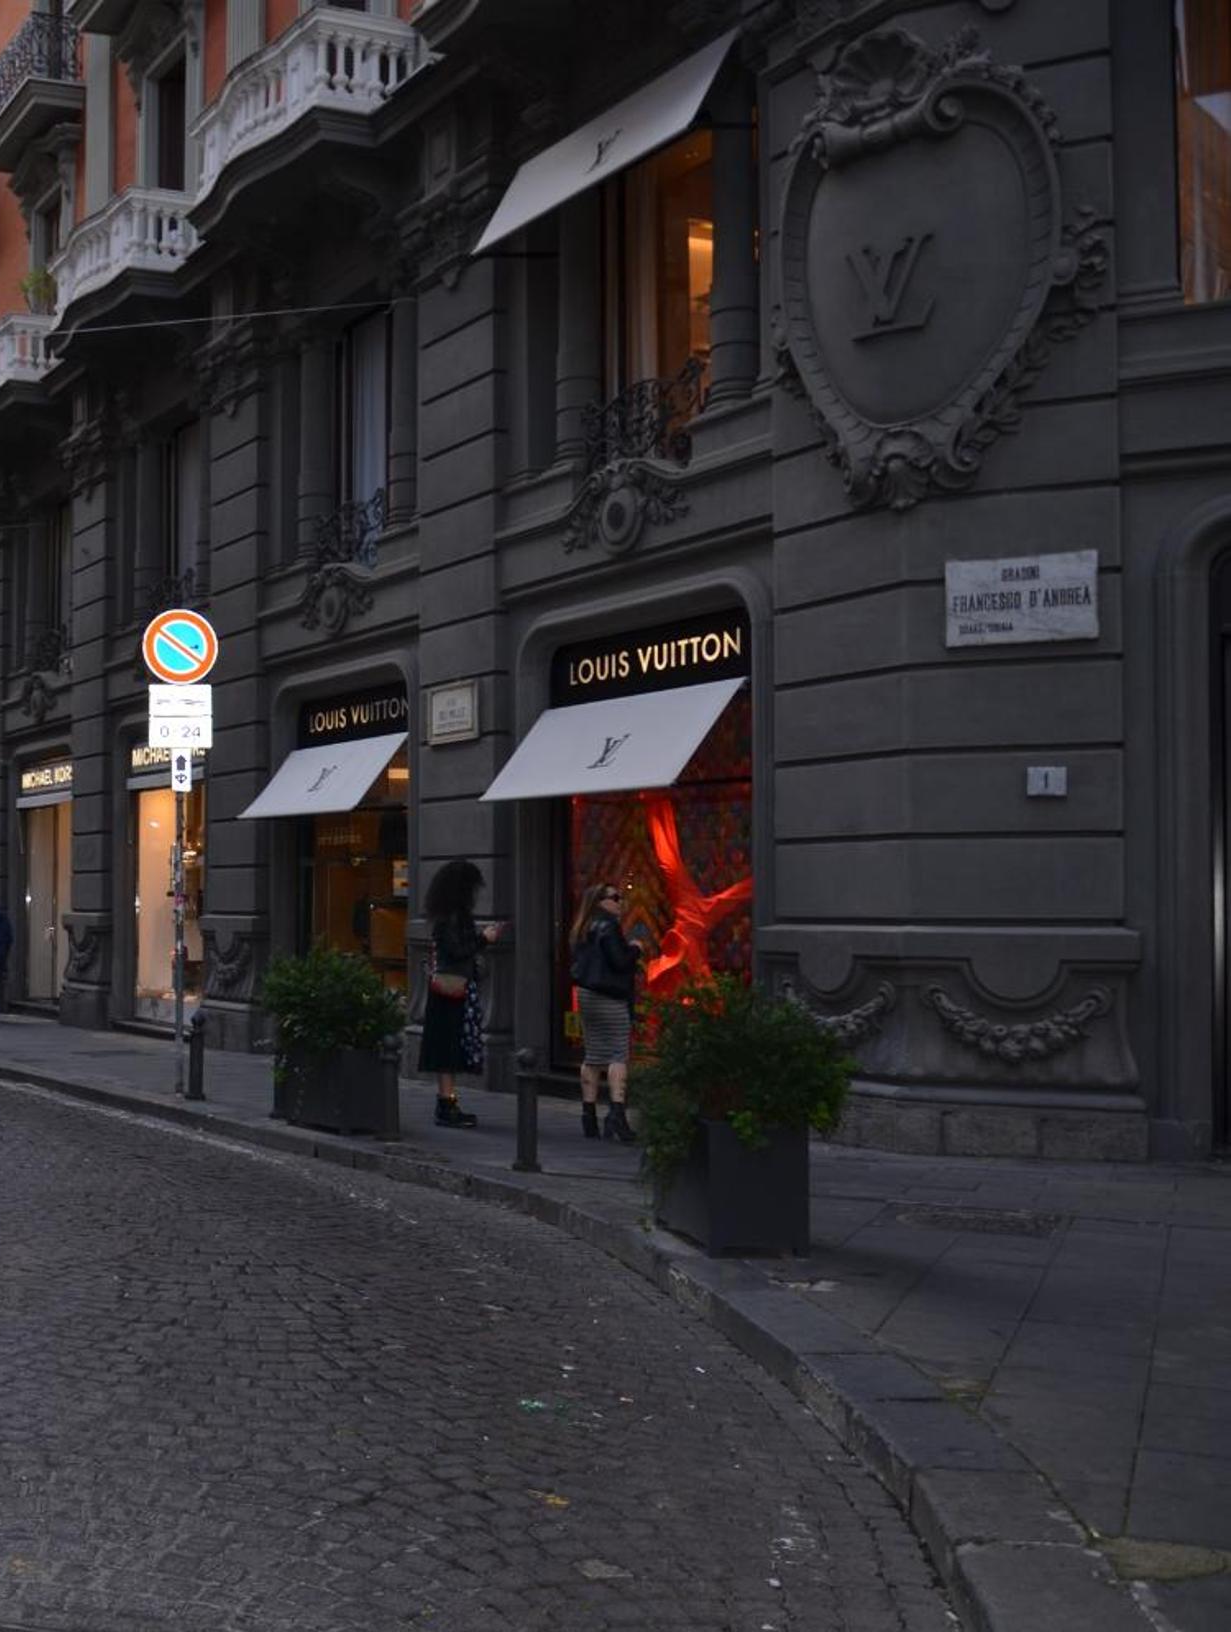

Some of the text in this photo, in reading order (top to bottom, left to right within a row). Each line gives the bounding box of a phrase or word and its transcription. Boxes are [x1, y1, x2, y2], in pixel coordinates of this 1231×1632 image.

[952, 590, 1022, 613] FRANCESCO
[570, 626, 741, 686] LOUIS VUITTON
[181, 726, 200, 738] 24
[309, 708, 347, 733] LOUIS
[132, 747, 171, 767] MICHAE
